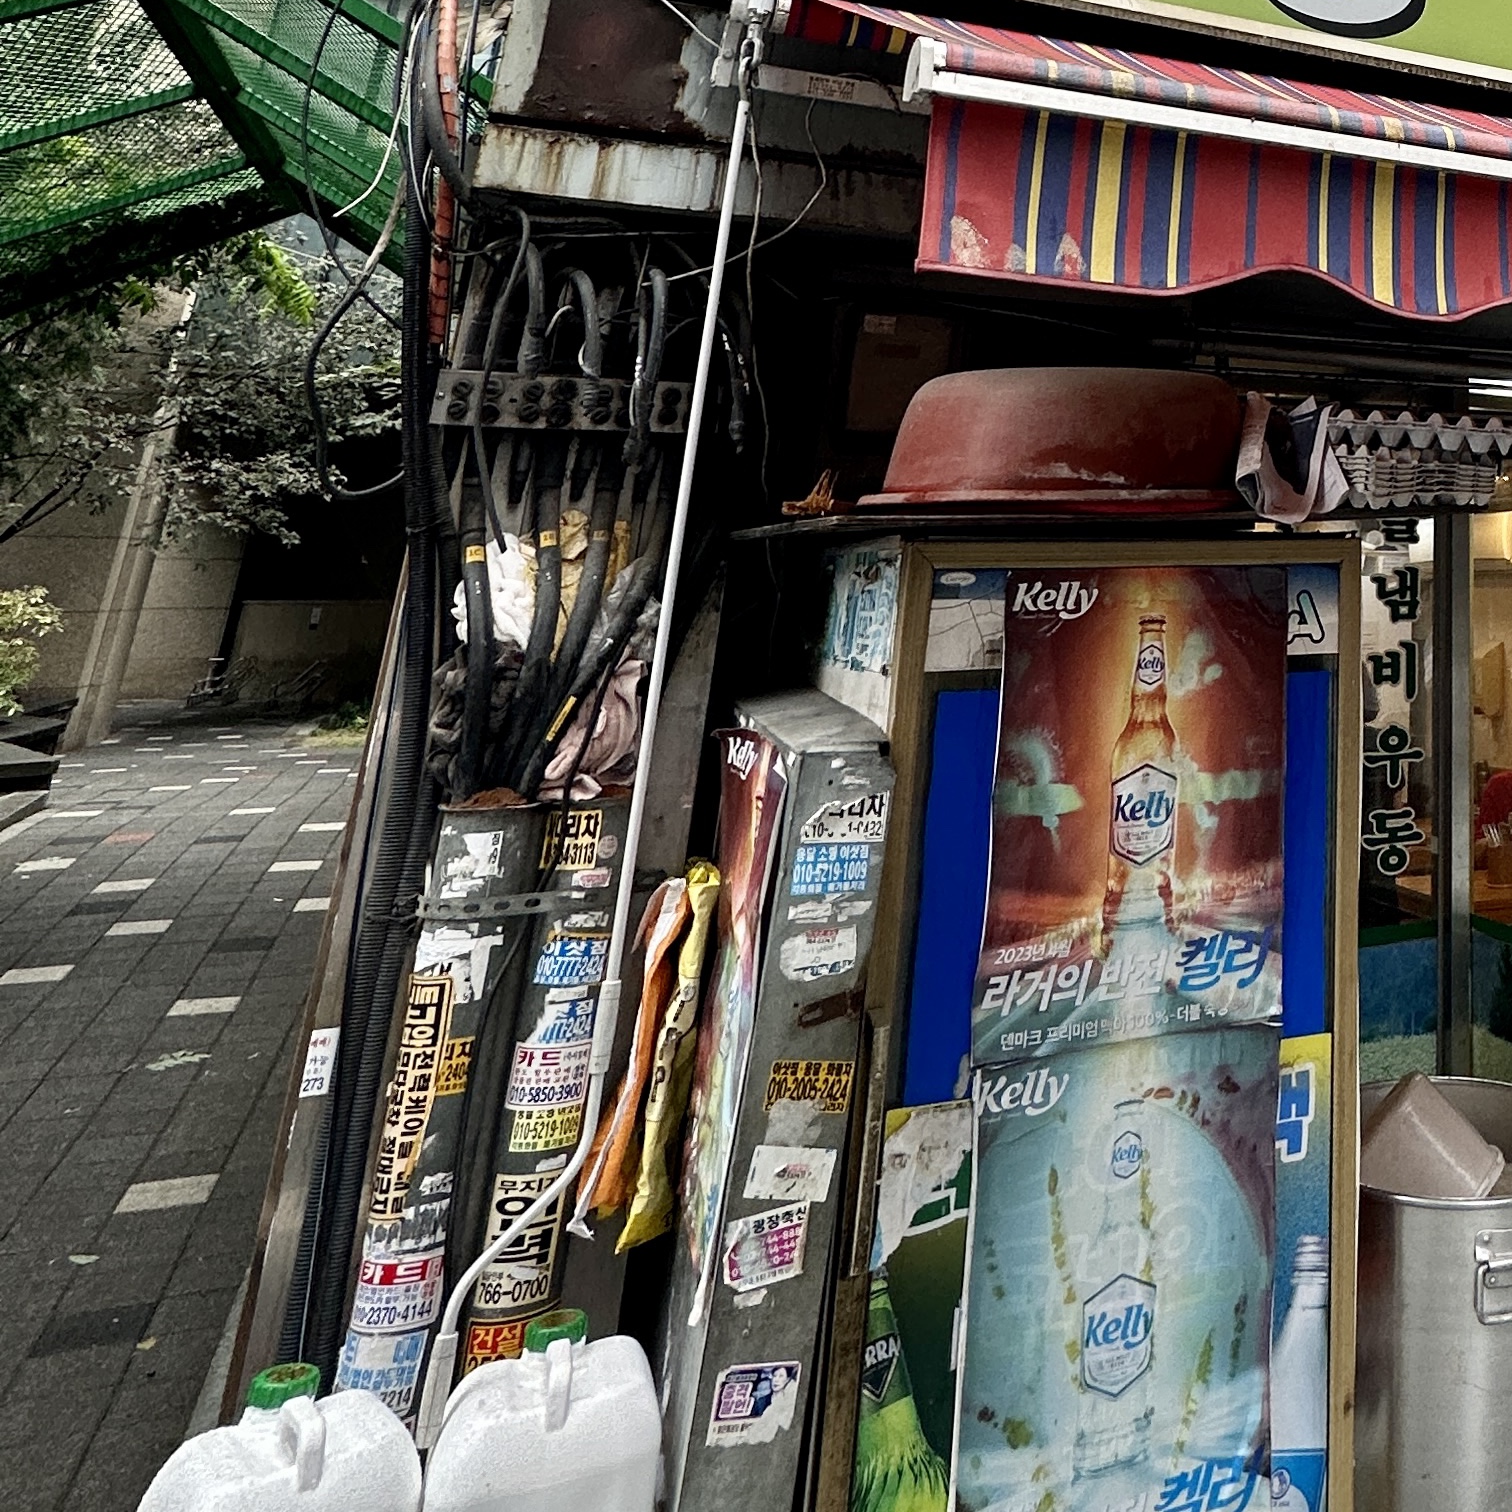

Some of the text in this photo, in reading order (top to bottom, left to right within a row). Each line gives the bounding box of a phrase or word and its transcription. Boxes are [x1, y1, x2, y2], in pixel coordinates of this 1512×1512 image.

[1012, 580, 1099, 620] Kelly
[728, 736, 758, 780] Kelly
[1114, 789, 1176, 828] Kelly
[995, 941, 1043, 965] 2023년
[1176, 920, 1271, 992] 켈리
[981, 960, 1093, 1018] 라거의
[1000, 1029, 1043, 1051] 덴마크
[1045, 1020, 1100, 1044] 프리미엄
[518, 1049, 562, 1067] 카드
[509, 1082, 582, 1104] 010-5850-3900
[978, 1067, 1070, 1117] Kelly
[362, 1260, 424, 1285] 카드
[478, 1274, 549, 1305] 766-0700
[472, 1327, 523, 1355] 건설
[1085, 1303, 1153, 1351] Kelly
